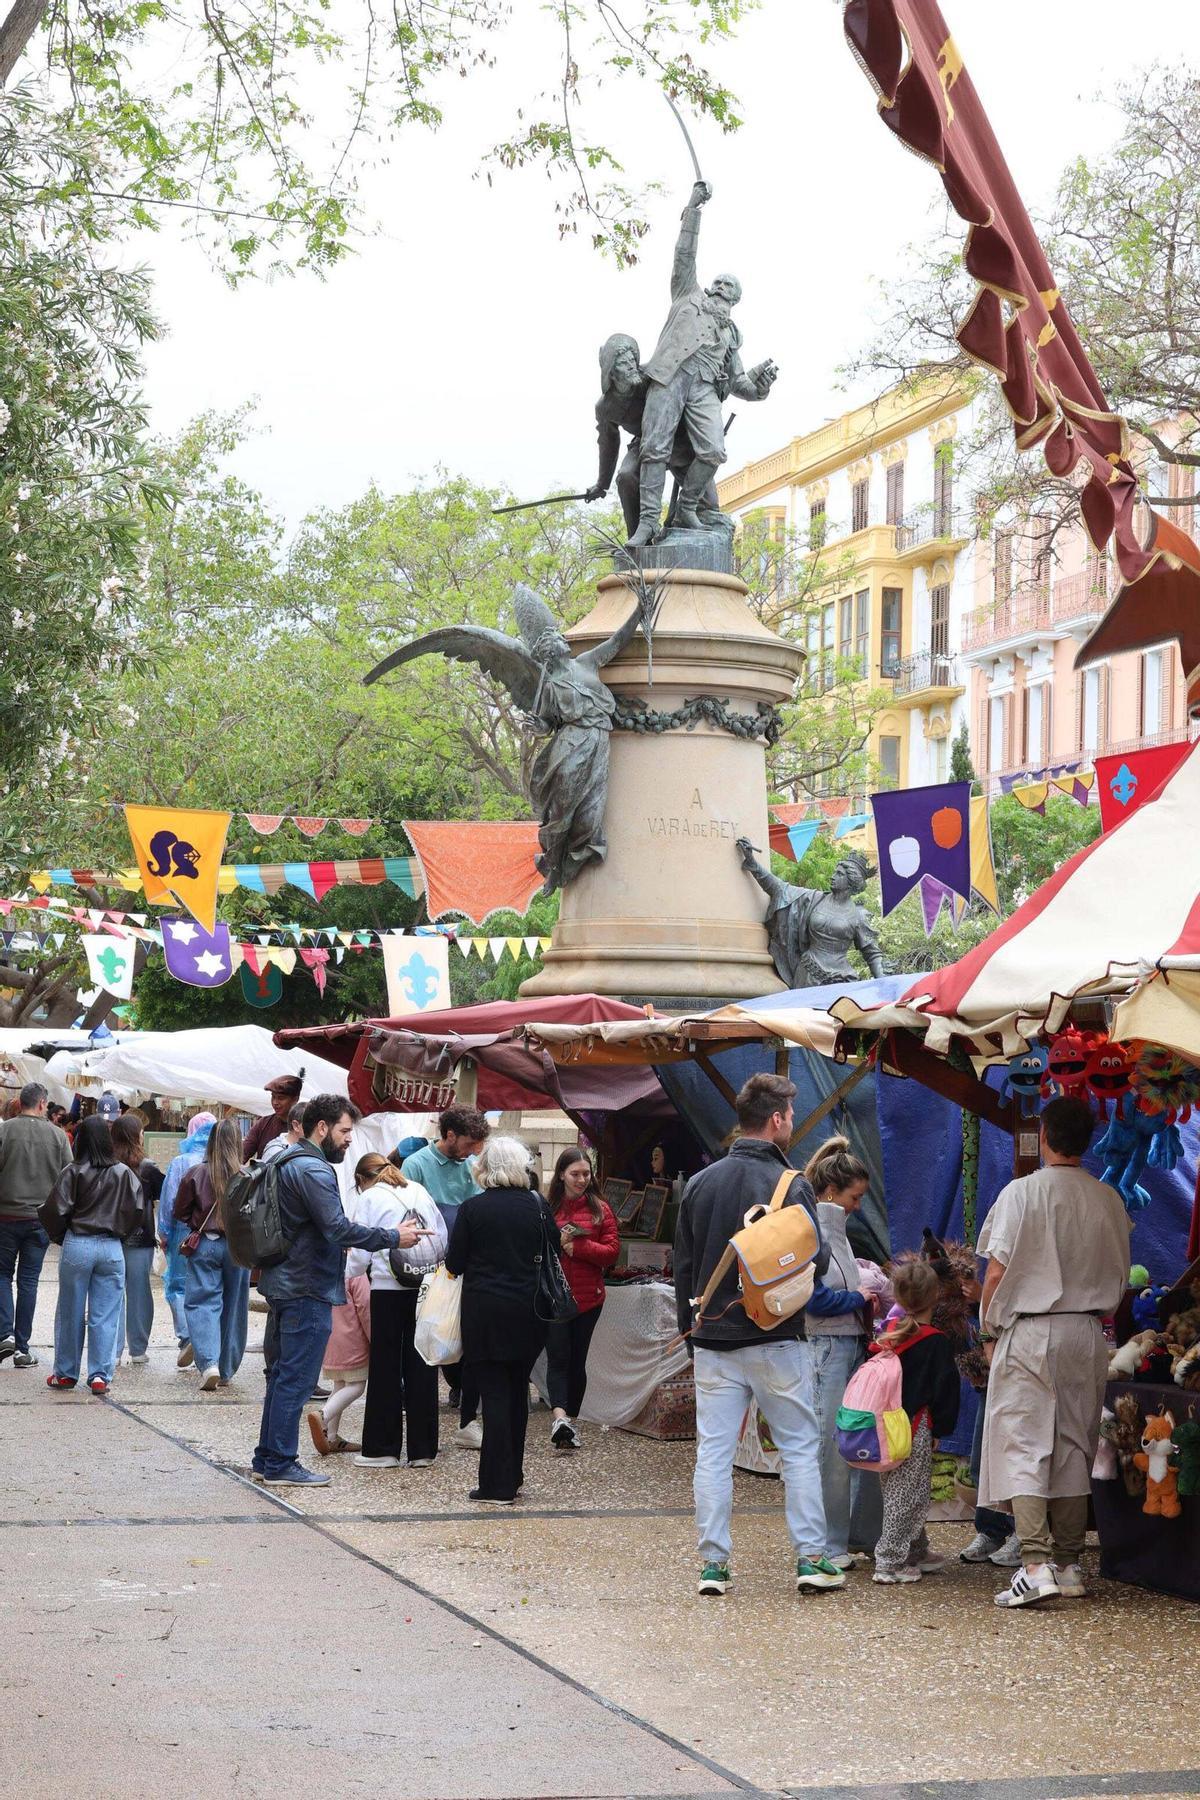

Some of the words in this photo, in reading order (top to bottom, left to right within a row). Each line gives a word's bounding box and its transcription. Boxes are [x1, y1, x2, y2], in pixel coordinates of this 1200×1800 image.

[688, 787, 704, 810] A
[646, 817, 691, 837] VARA
[710, 819, 739, 840] REY
